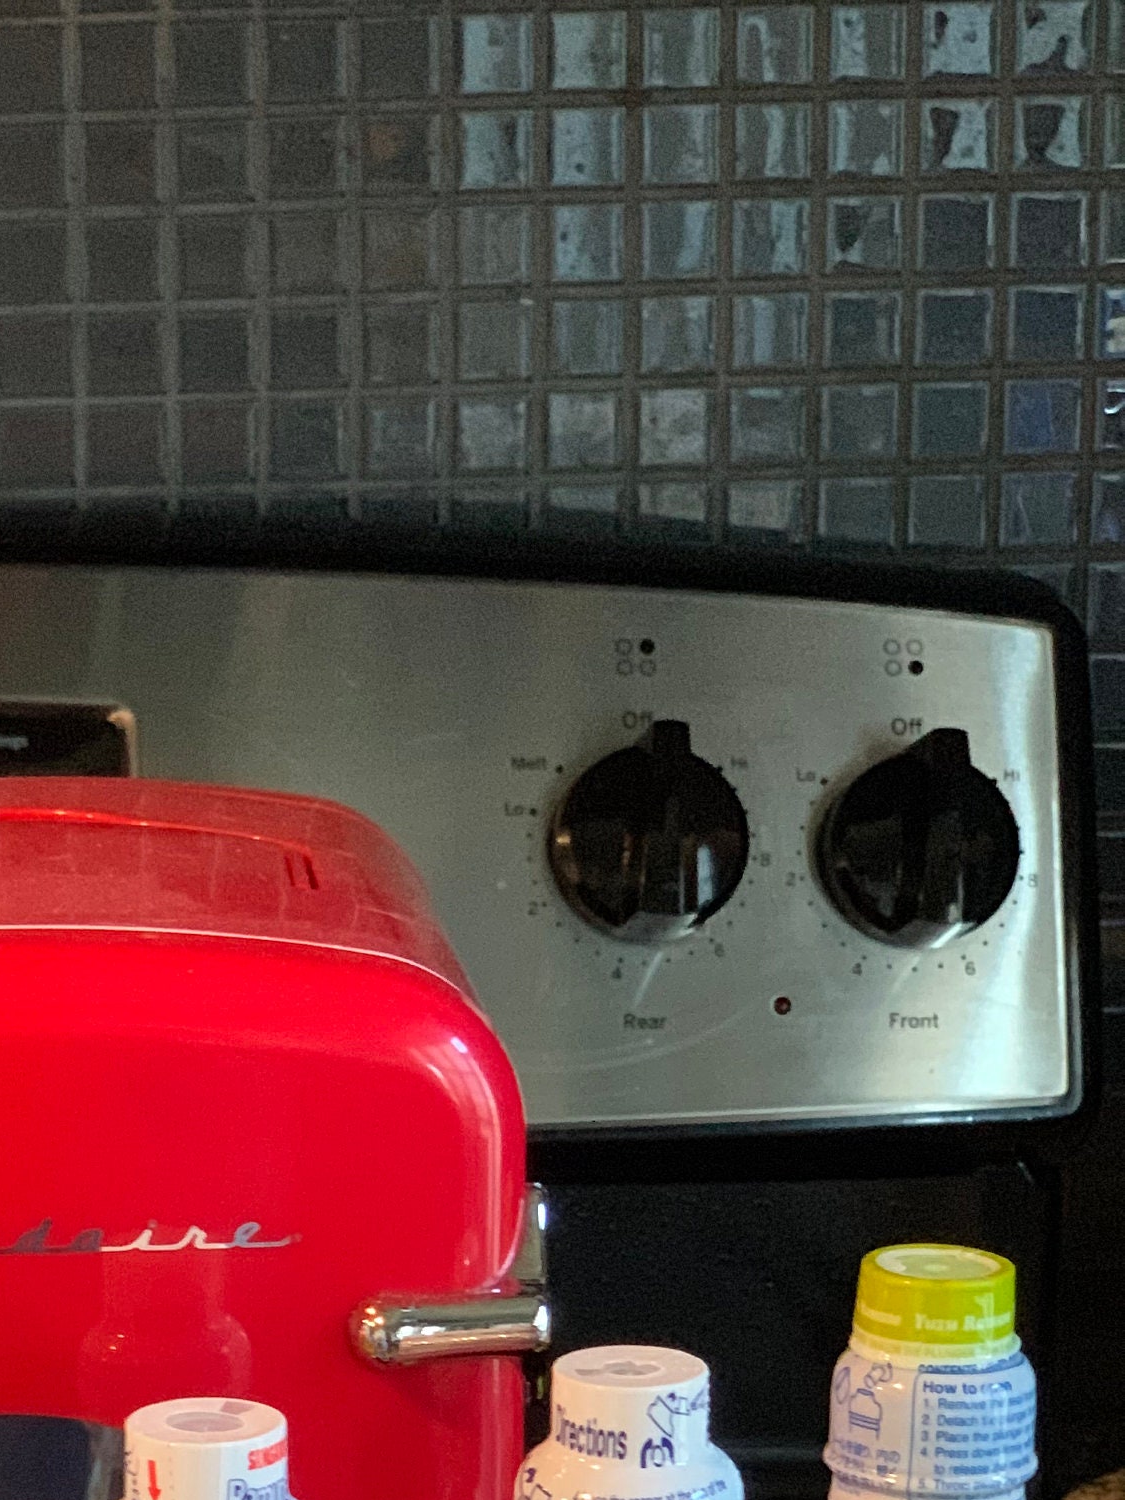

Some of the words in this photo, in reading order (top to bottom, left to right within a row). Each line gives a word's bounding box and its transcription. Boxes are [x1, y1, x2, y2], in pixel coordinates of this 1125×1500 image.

[891, 718, 923, 735] Off
[851, 962, 862, 976] 4
[965, 962, 976, 976] 6
[623, 1014, 667, 1030] Rear
[889, 1012, 939, 1030] Front
[922, 1380, 958, 1395] How
[962, 1382, 978, 1395] to
